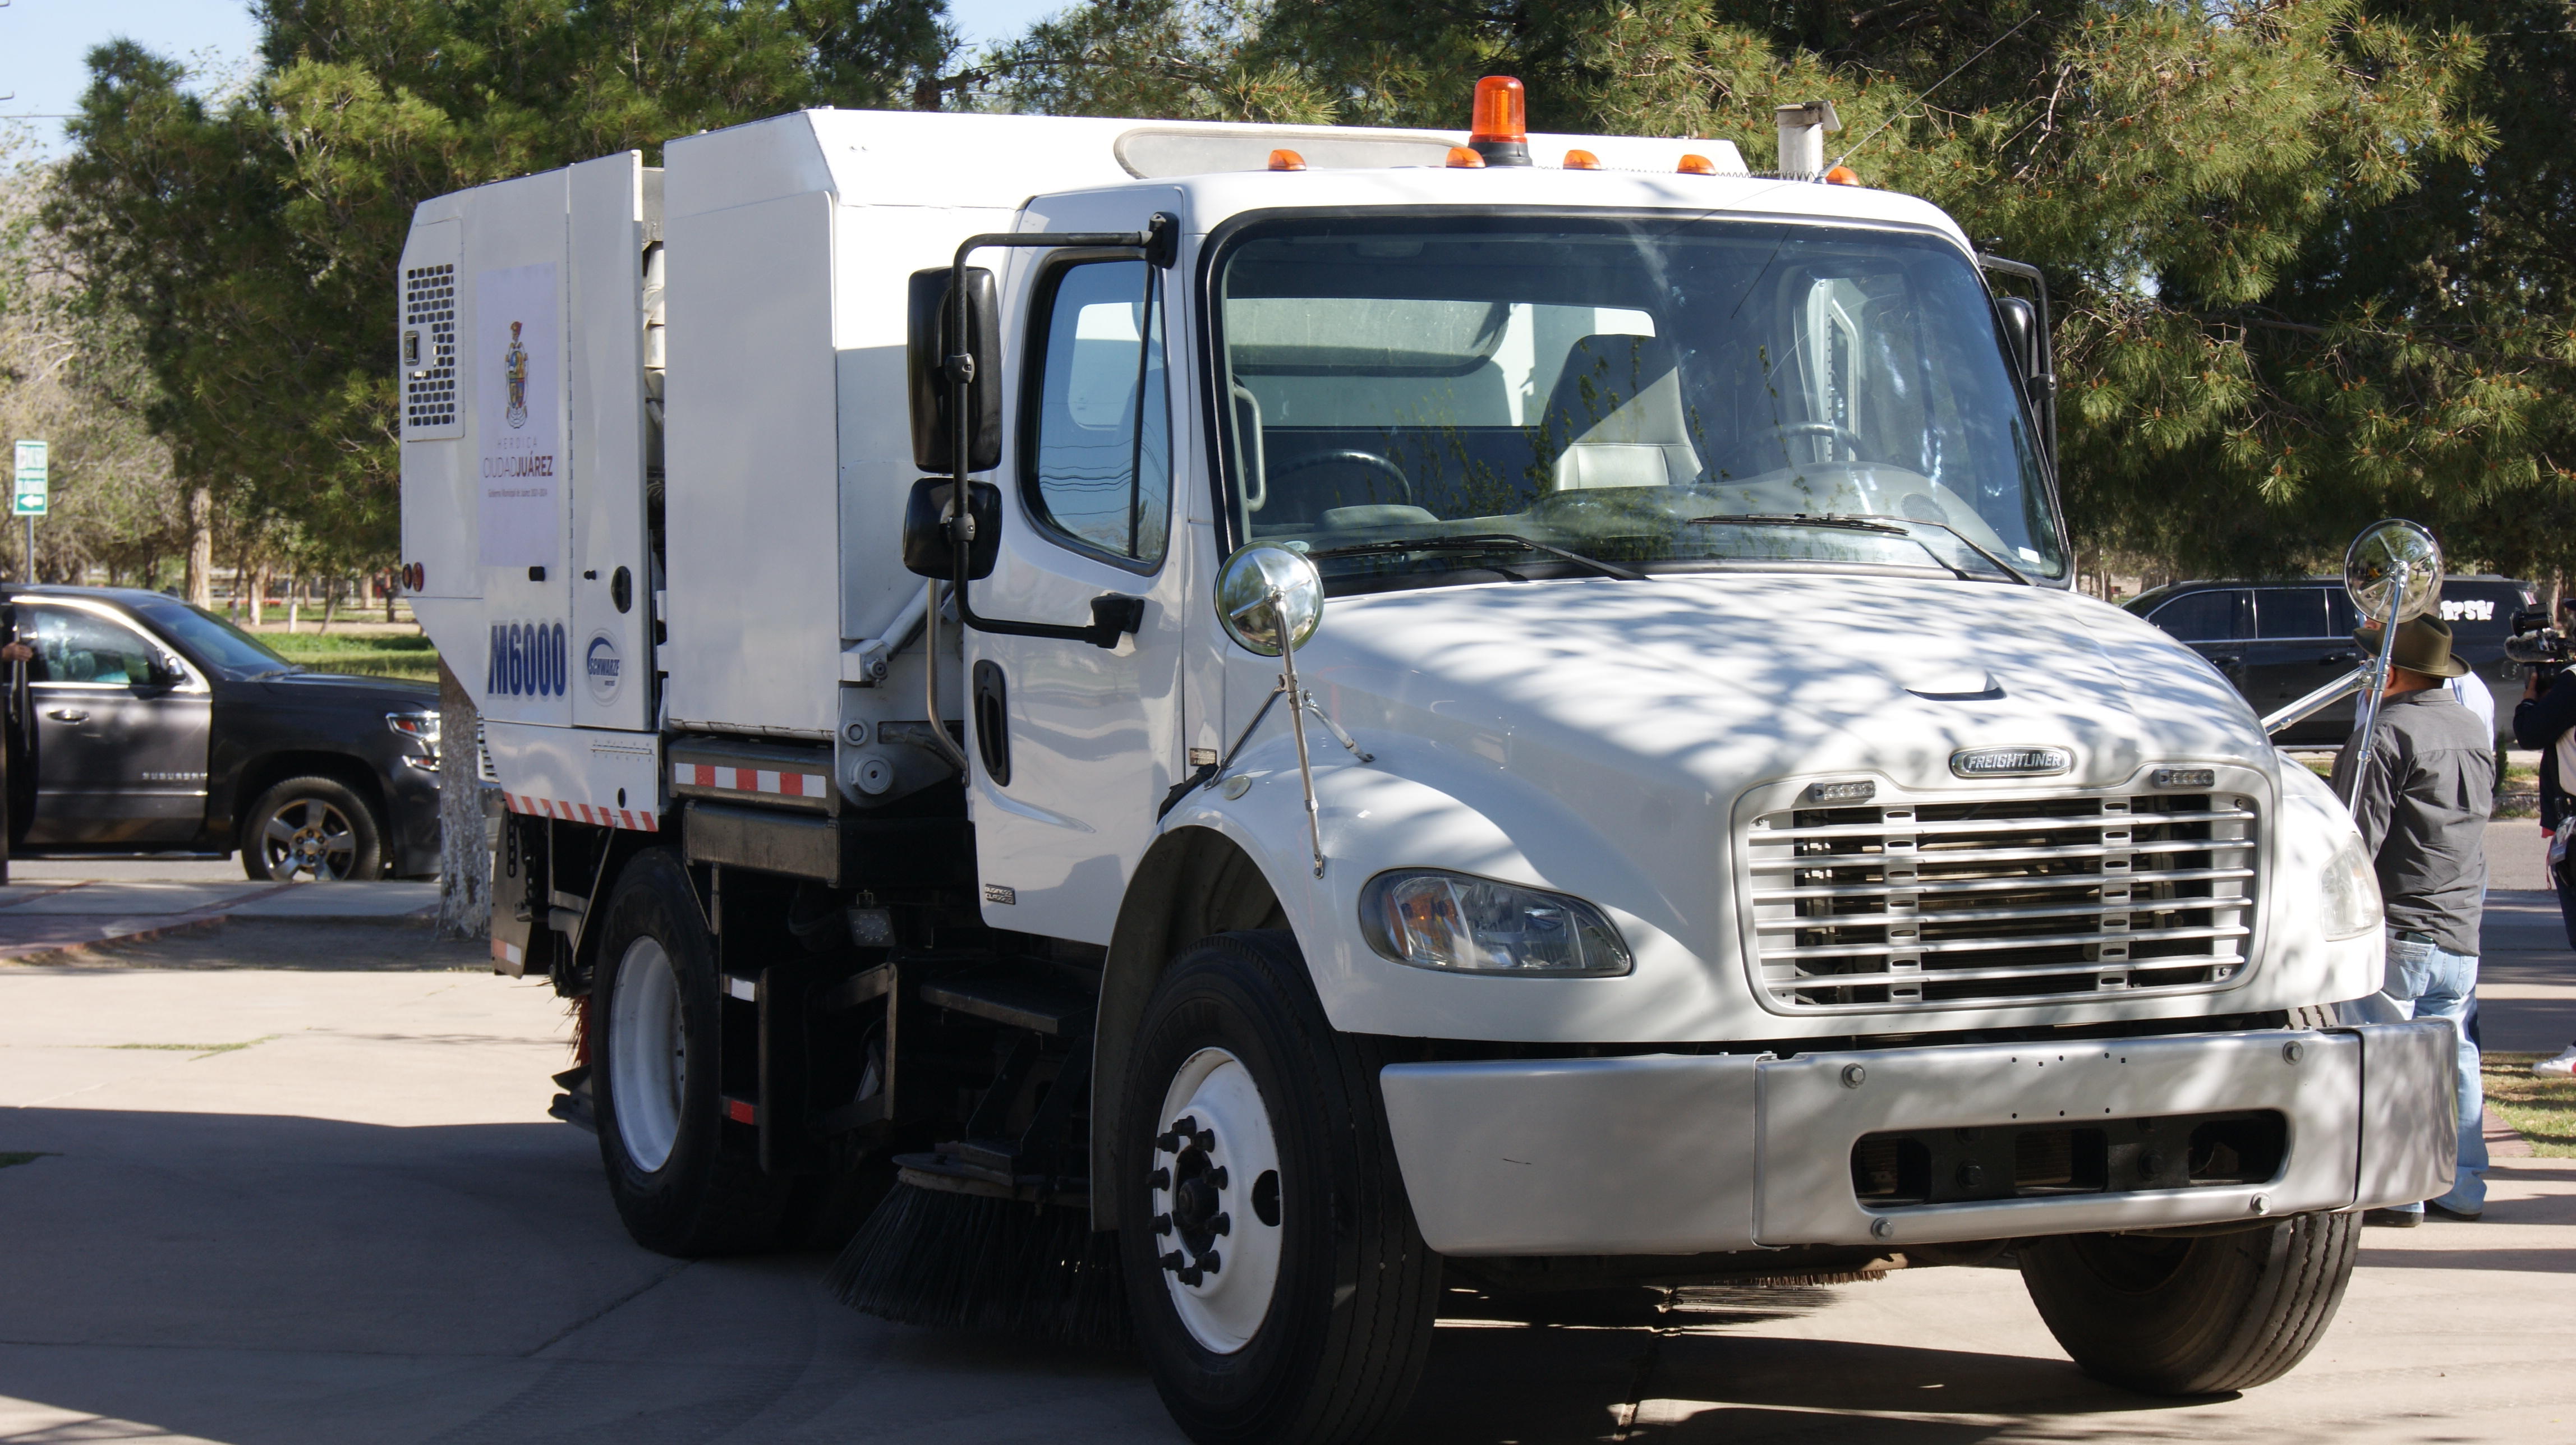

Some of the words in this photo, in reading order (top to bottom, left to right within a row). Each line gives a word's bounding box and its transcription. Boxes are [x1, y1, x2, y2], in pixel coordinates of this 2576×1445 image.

[497, 436, 537, 449] HEROICA
[488, 623, 565, 697] M6000
[588, 657, 620, 677] SCHWARZE
[1967, 753, 2061, 770] FREIGHTLINER
[142, 772, 208, 780] SUBURBAN
